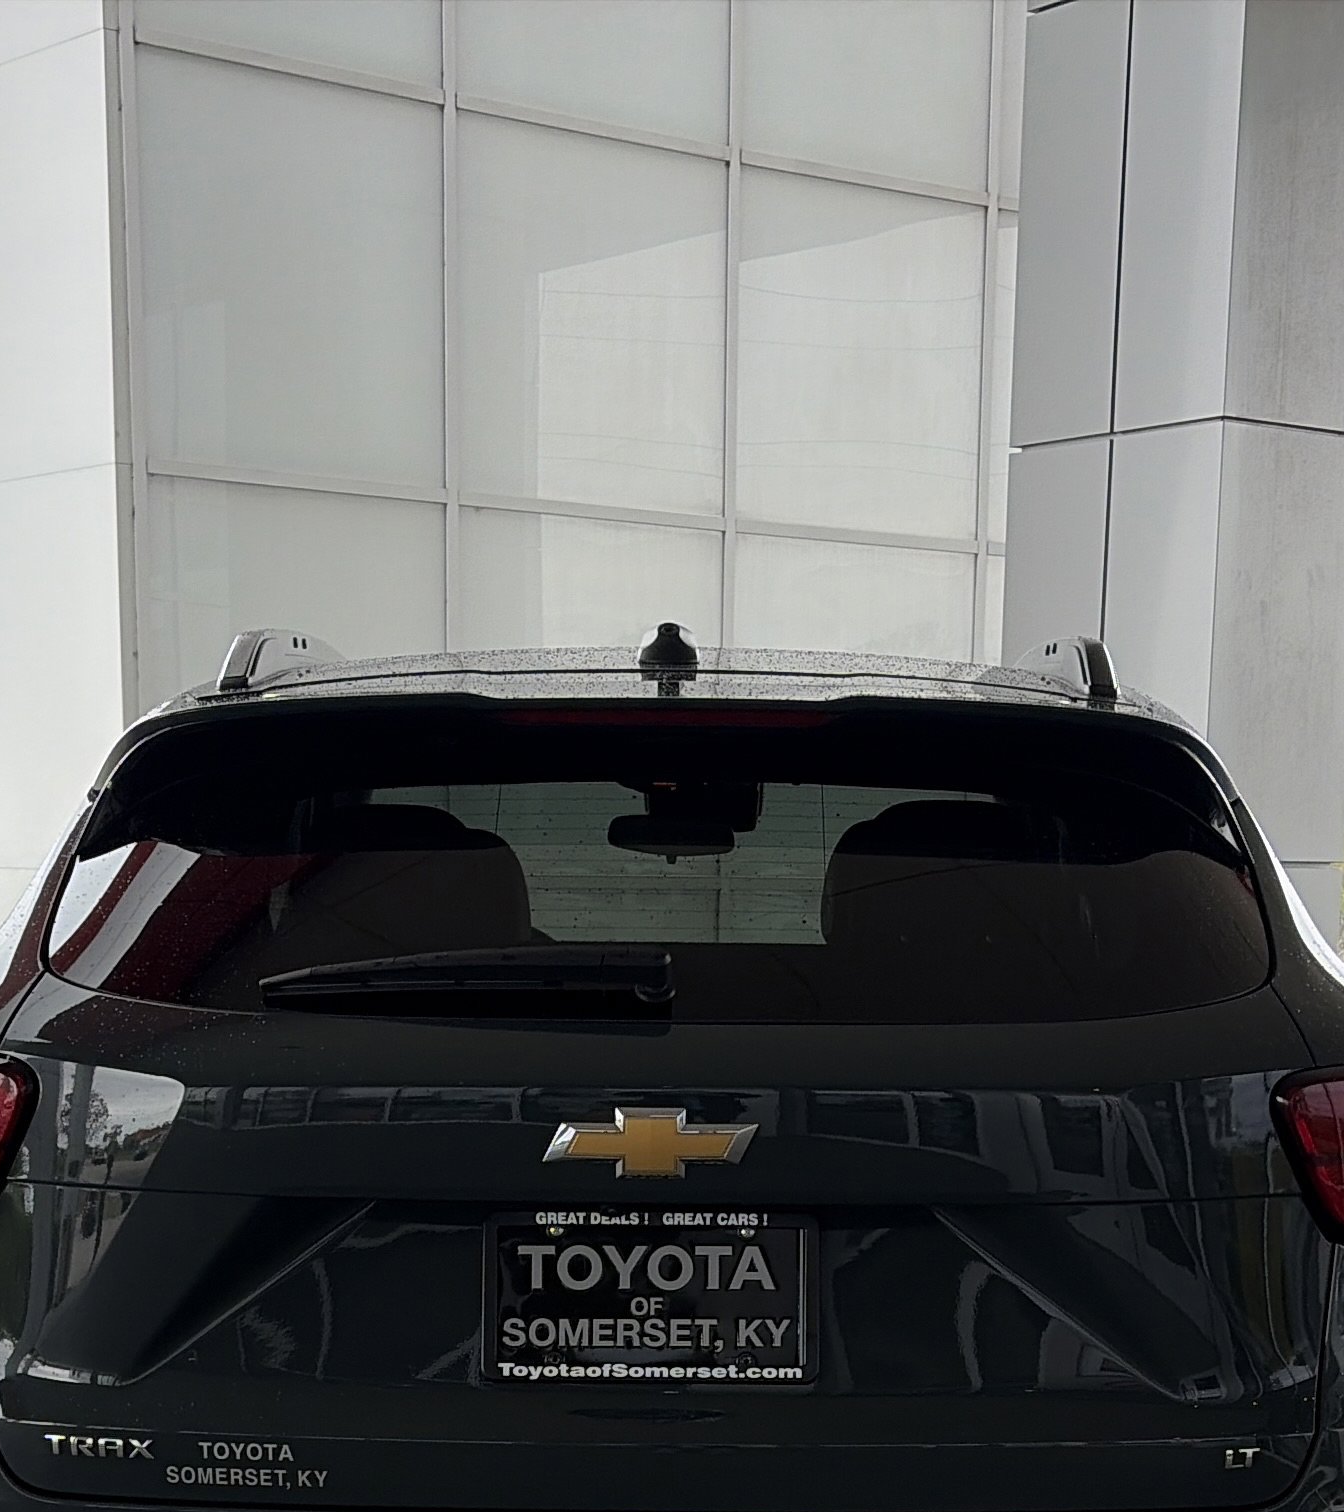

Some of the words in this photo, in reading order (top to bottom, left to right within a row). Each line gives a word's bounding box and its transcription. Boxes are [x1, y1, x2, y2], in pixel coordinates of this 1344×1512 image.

[535, 1212, 586, 1226] GREAT
[662, 1213, 712, 1227] GREAT
[716, 1213, 759, 1227] CARS
[517, 1245, 775, 1290] TOYOTA
[630, 1297, 664, 1317] OF
[502, 1318, 725, 1352] SOMERSET,
[736, 1319, 791, 1348] KY
[498, 1363, 803, 1380] ToyotaofSomerset.com
[44, 1434, 155, 1459] TRAX
[198, 1441, 294, 1462] TOYOTA
[1225, 1448, 1260, 1469] LT
[166, 1466, 292, 1489] SOMERSET,
[297, 1470, 328, 1488] KY
